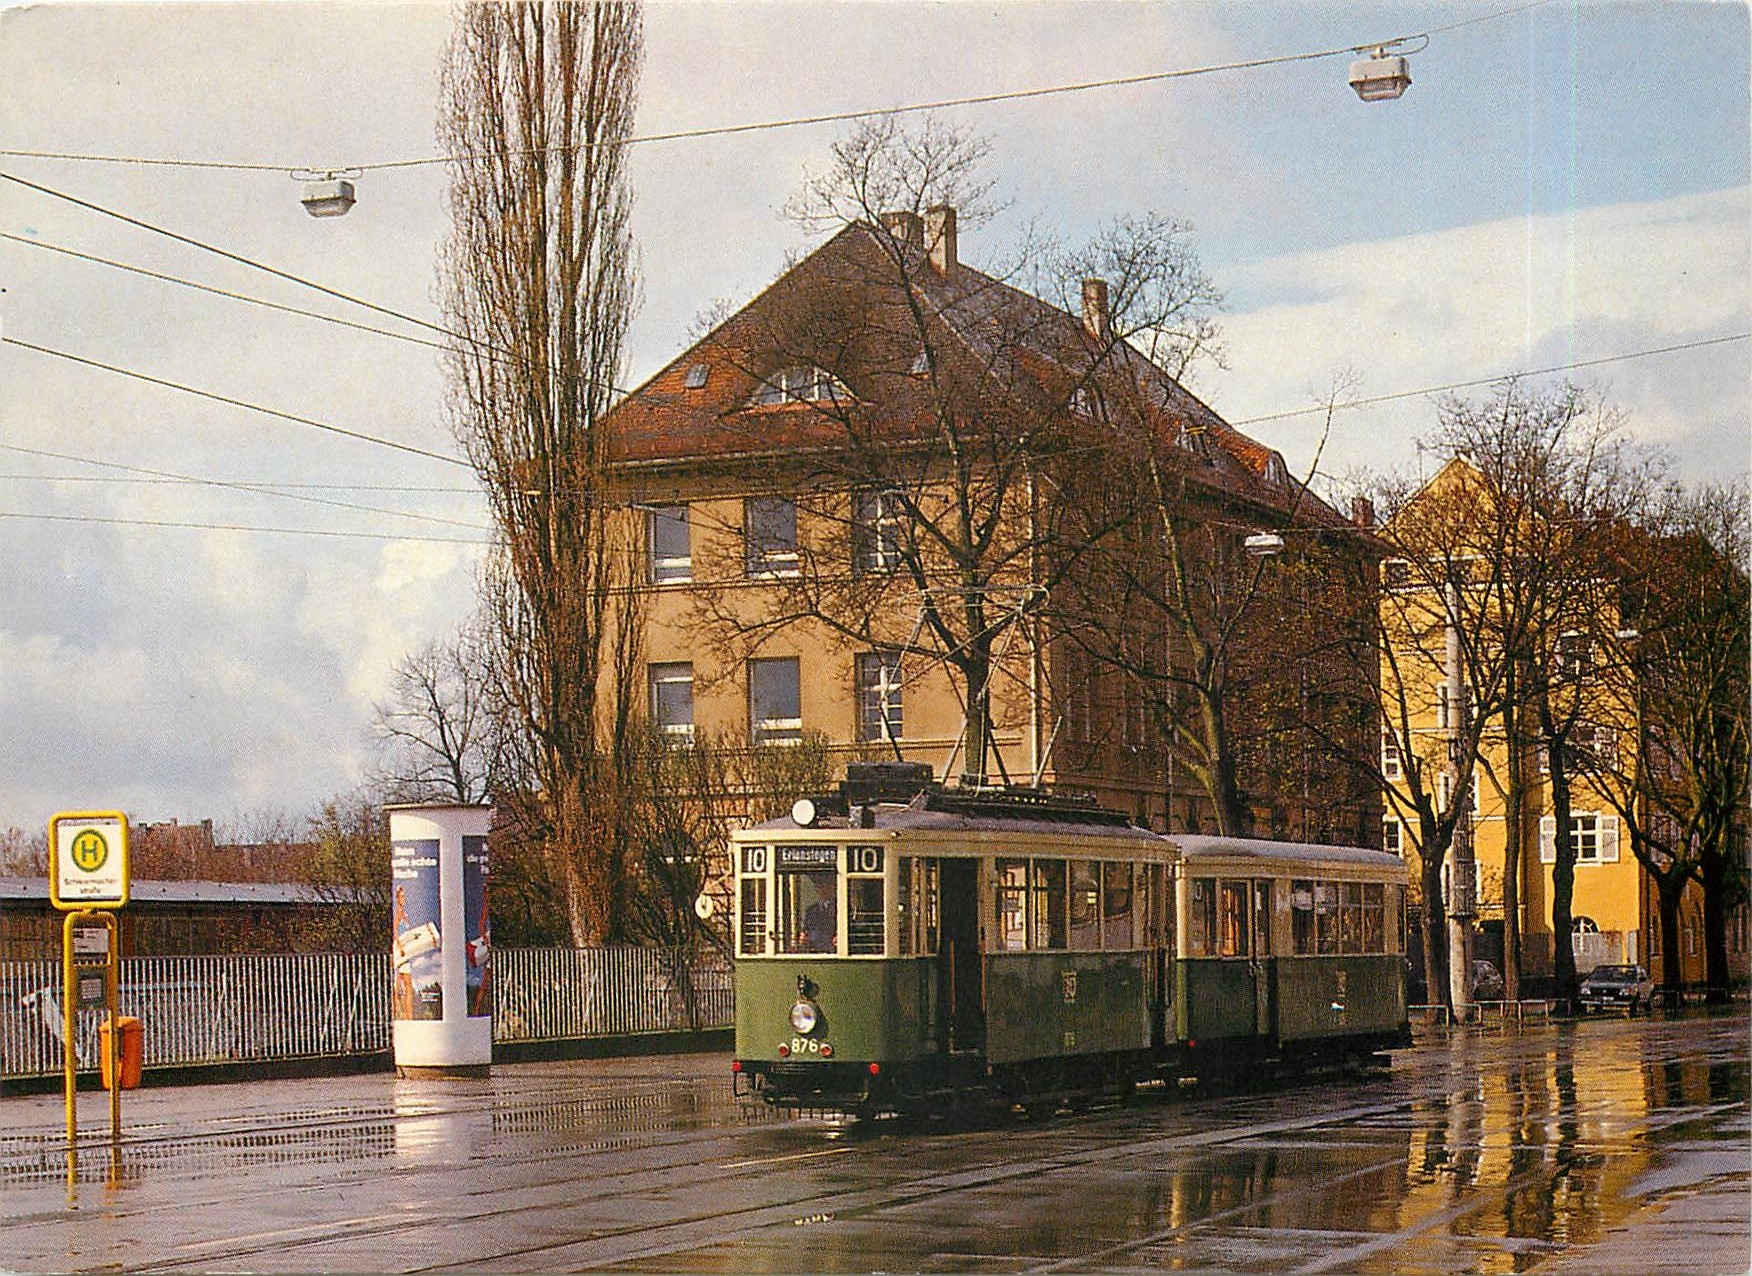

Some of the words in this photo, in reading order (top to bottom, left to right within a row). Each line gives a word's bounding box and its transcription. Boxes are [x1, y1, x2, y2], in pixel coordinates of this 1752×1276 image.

[81, 839, 98, 862] H
[747, 848, 766, 872] 10
[853, 848, 878, 872] 10
[791, 1037, 819, 1053] 876
